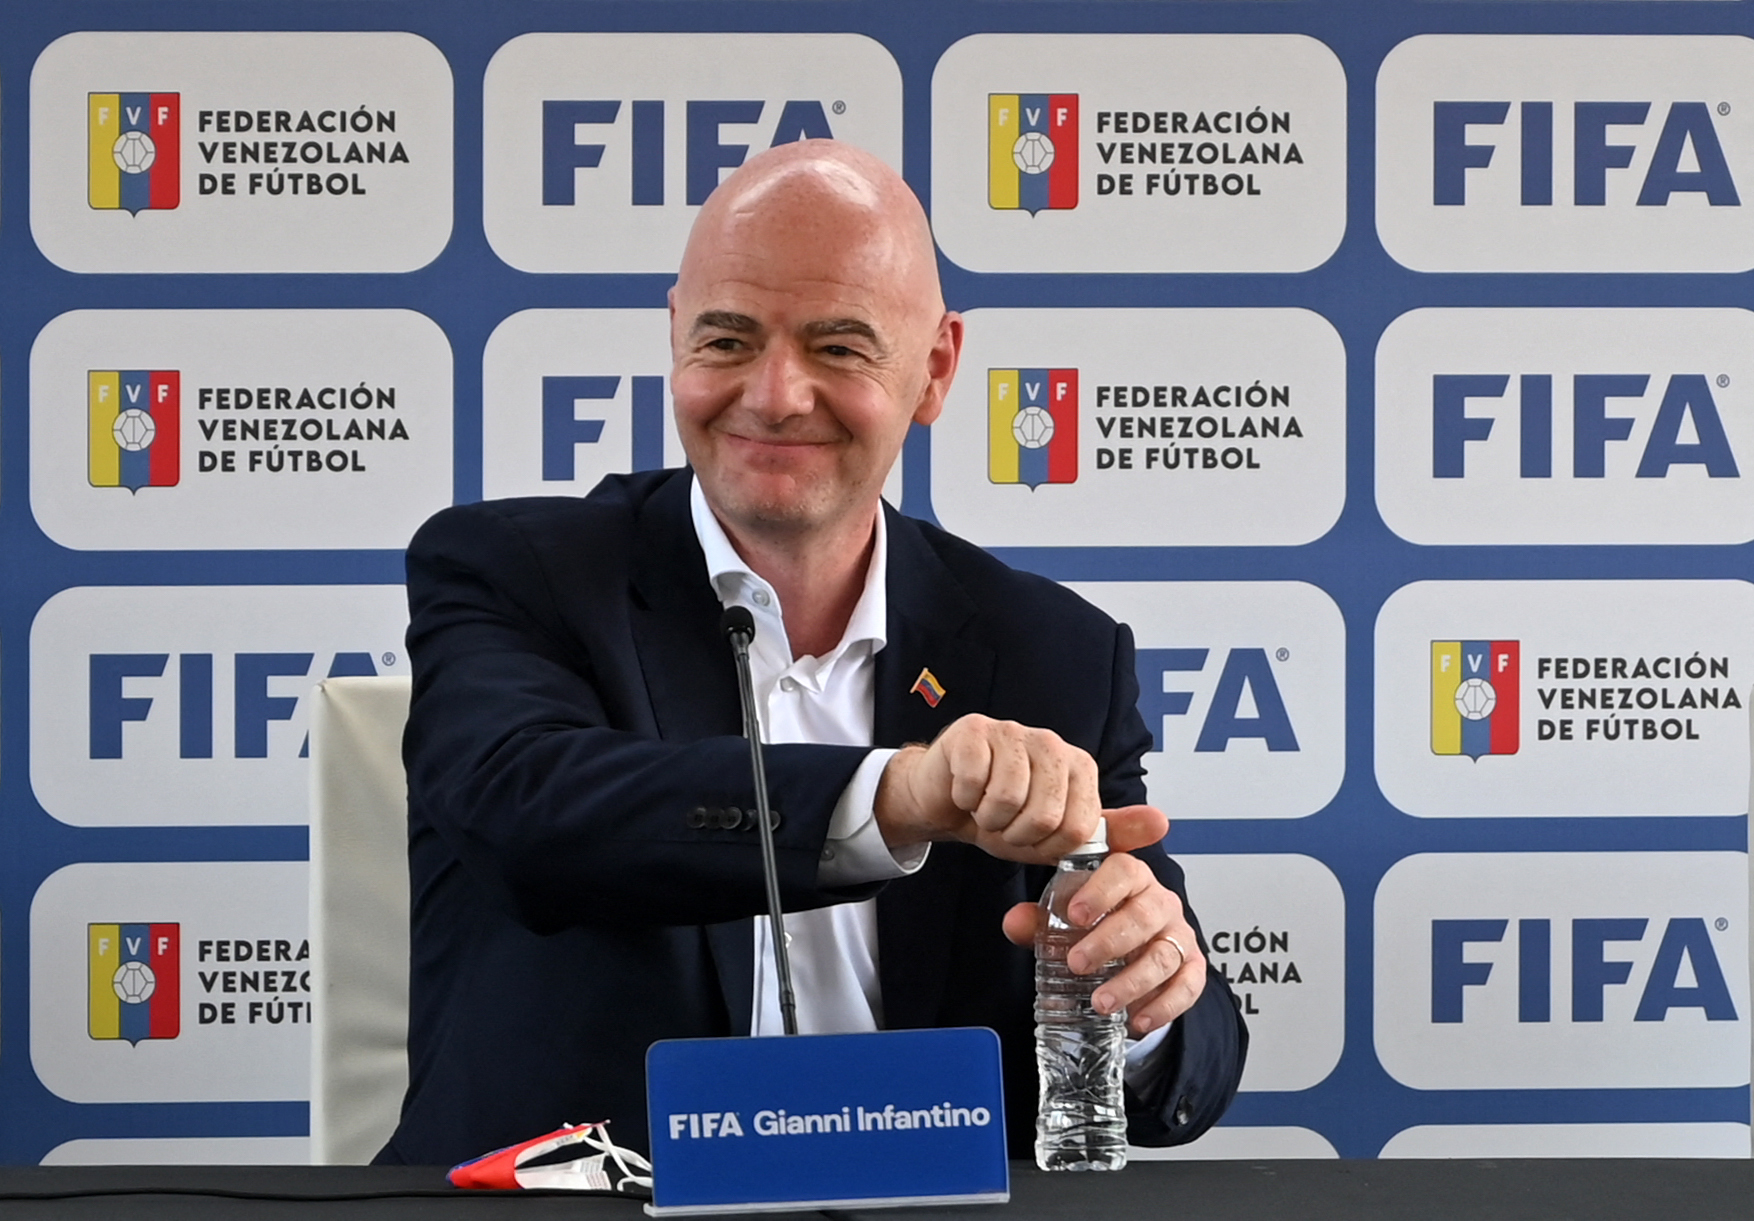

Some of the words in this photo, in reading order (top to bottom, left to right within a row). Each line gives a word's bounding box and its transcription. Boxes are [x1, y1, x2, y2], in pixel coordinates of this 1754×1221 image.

[198, 105, 396, 133] FEDERACIÓN
[1097, 106, 1290, 134] FEDERACIÓN
[198, 142, 410, 164] VENEZOLANA
[1096, 143, 1304, 165] VENEZOLANA
[1434, 101, 1741, 206] FIFA
[198, 172, 236, 196] DE
[249, 167, 366, 196] FÚTBOL
[1097, 173, 1133, 196] DE
[1146, 168, 1261, 196] FÚTBOL
[198, 382, 396, 410] FEDERACIÓN
[1096, 380, 1290, 408] FEDERACIÓN
[198, 419, 410, 441] VENEZOLANA
[1096, 417, 1304, 439] VENEZOLANA
[1433, 374, 1740, 479] FIFA
[198, 449, 236, 473] DE
[249, 445, 366, 473] FÚTBOL
[1097, 447, 1133, 470] DE
[1145, 442, 1261, 470] FÚTBOL
[1538, 652, 1729, 679] FEDERACIÓN
[89, 652, 378, 760] FIF
[1136, 648, 1300, 752] FA
[1537, 688, 1742, 710] VENEZOLANA
[1538, 718, 1574, 741] DE
[1586, 714, 1700, 741] FÚTBOL
[198, 940, 310, 962] FEDERA
[1432, 917, 1739, 1023] FIFA
[198, 1002, 236, 1025] DE
[669, 1112, 744, 1139] FIFA
[753, 1106, 851, 1136] Gianni
[857, 1101, 991, 1131] Infantino
